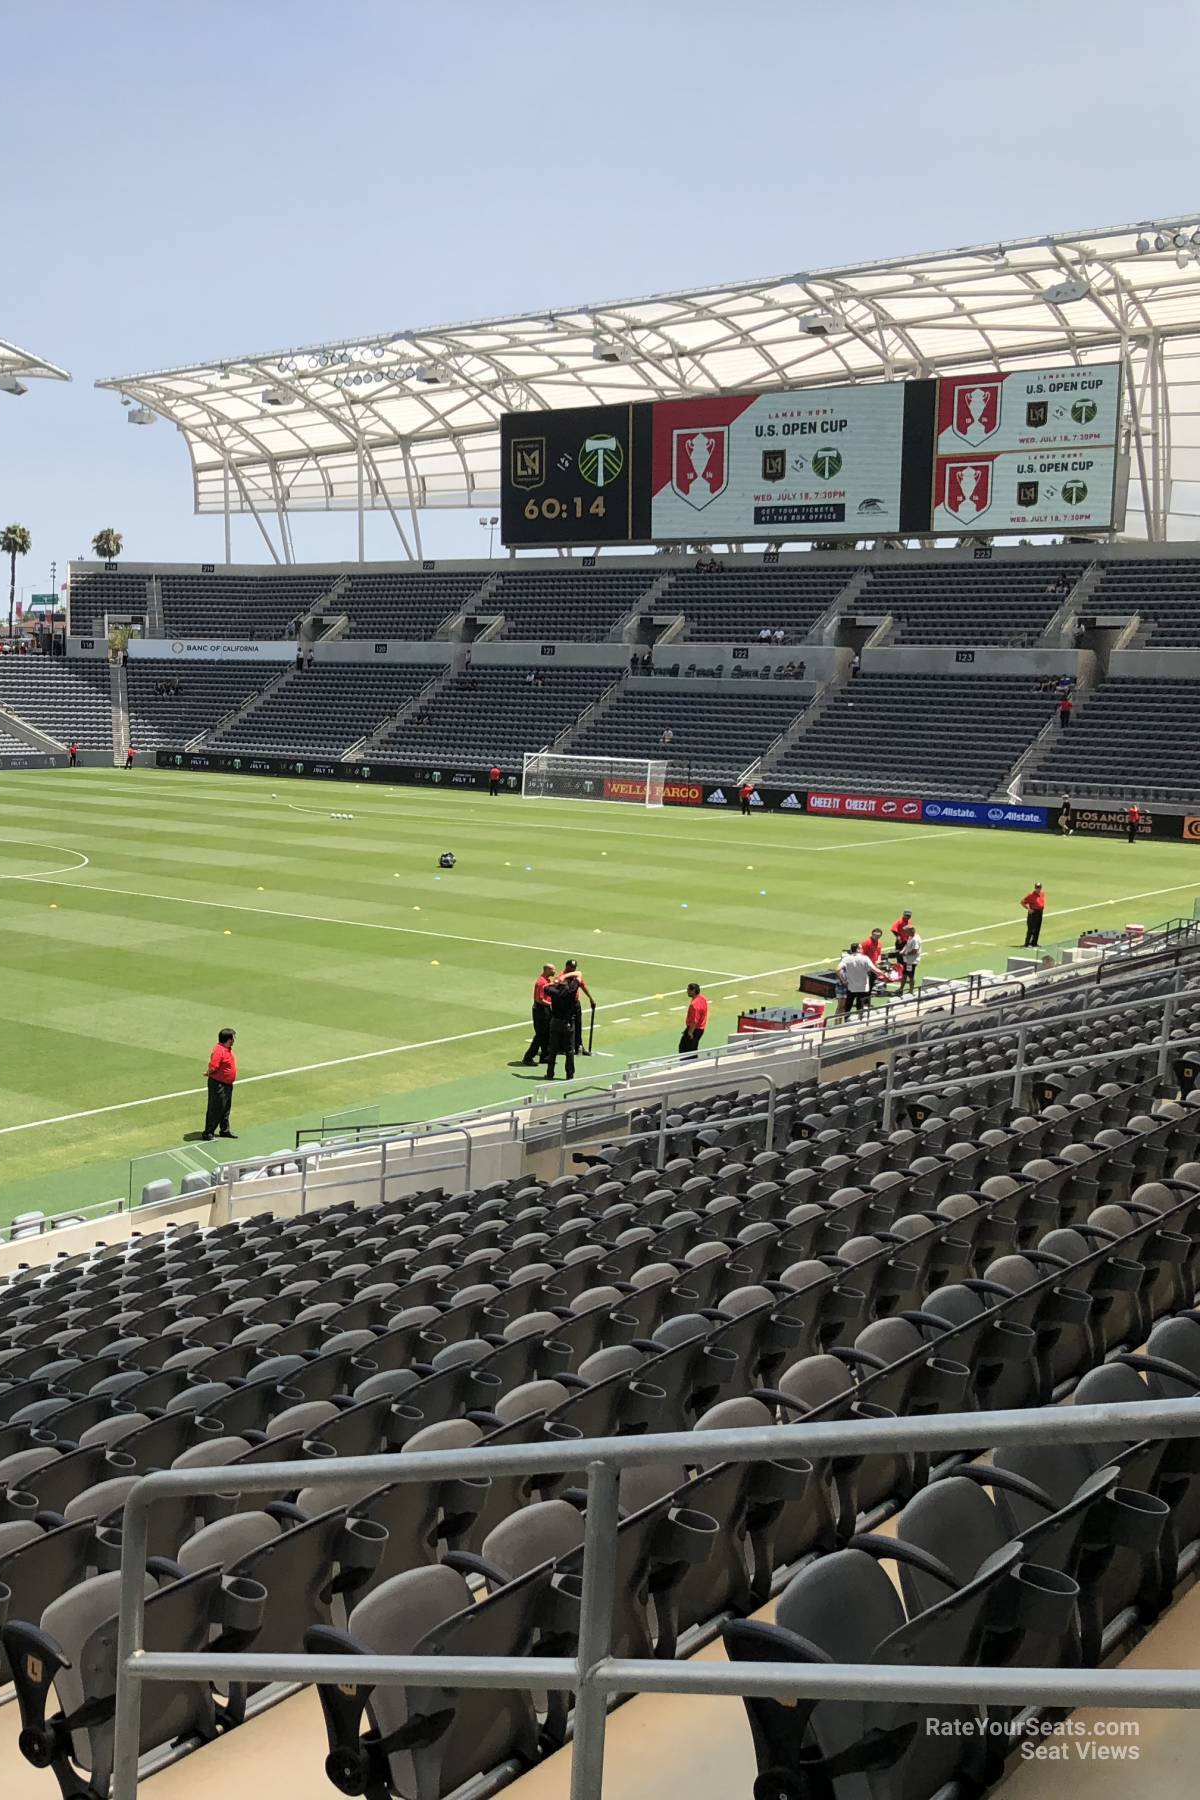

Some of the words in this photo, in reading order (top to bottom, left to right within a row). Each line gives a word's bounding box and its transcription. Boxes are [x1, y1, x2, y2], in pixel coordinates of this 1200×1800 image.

[1026, 384, 1046, 394] U.S.
[1049, 381, 1078, 392] OPEN
[1081, 379, 1103, 390] CUP
[755, 424, 778, 437] U.S.
[782, 421, 817, 435] OPEN
[821, 419, 848, 433] CUP
[1017, 463, 1037, 474] U.S.
[1040, 462, 1069, 472] OPEN
[1071, 461, 1094, 471] CUP
[753, 494, 774, 502] WED.
[777, 492, 797, 501] JULY
[814, 490, 846, 499] 7:30PM
[524, 495, 606, 519] 60:14
[976, 551, 991, 560] 223
[187, 644, 208, 652] BANC
[543, 648, 554, 656] 121
[735, 650, 748, 658] 122
[959, 653, 972, 661] 123
[608, 783, 651, 795] WELLS
[655, 786, 699, 799] FARGO
[810, 796, 841, 808] CHEEZ-IT
[845, 798, 877, 811] CHEEZ-IT
[1077, 811, 1098, 821] LOS
[1076, 821, 1125, 832] FOOTBALL
